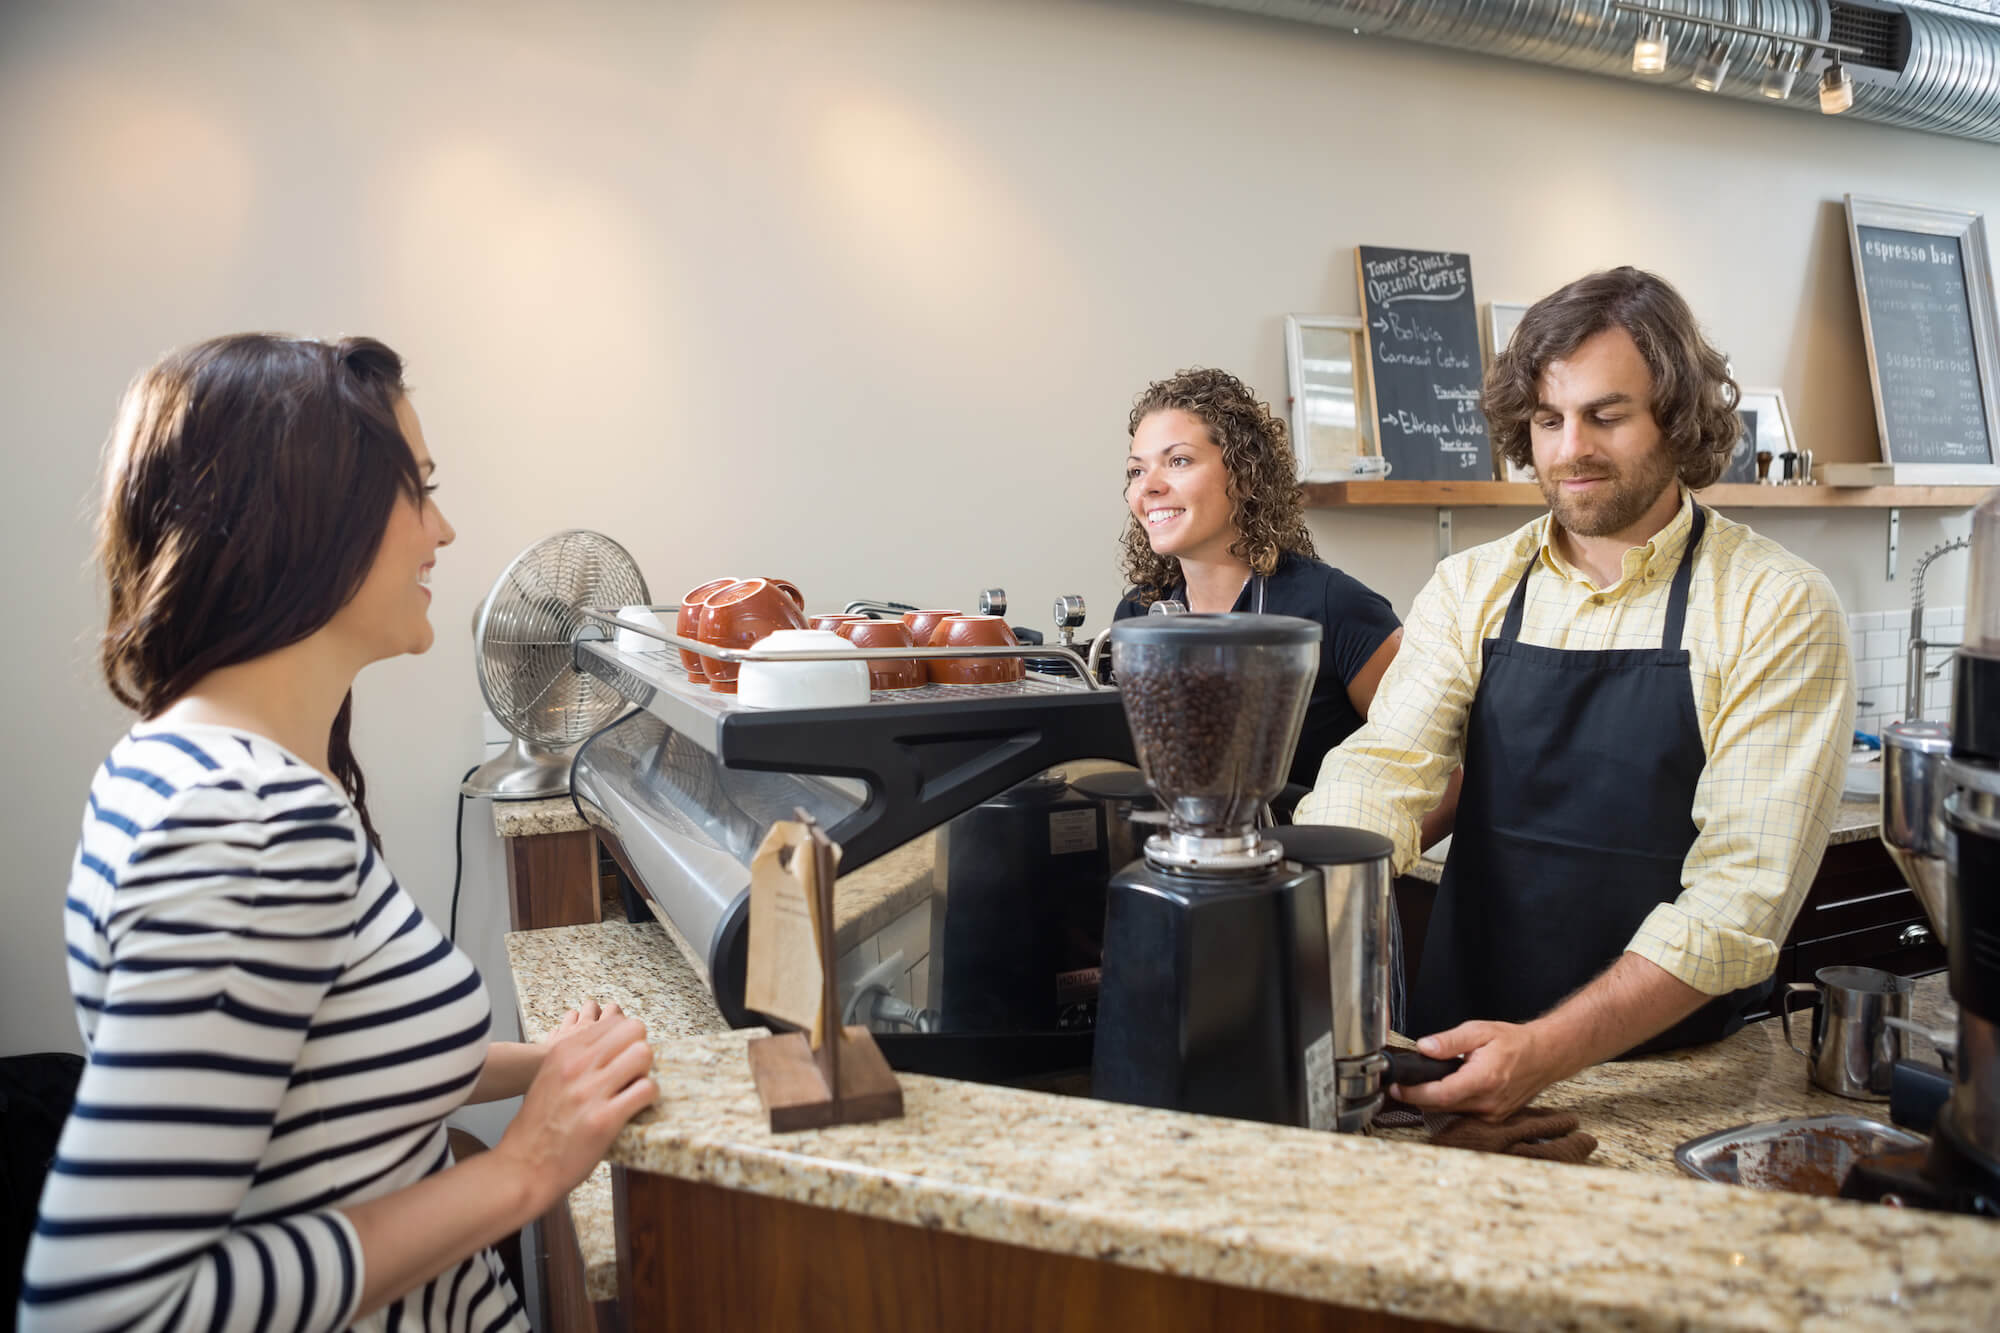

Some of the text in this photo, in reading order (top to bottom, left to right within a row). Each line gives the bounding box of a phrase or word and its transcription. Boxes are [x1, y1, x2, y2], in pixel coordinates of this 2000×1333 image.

[1408, 254, 1454, 276] SINGLE
[1865, 240, 1955, 265] espresso bar
[1368, 267, 1466, 304] ORIGIN COFFEE
[1388, 311, 1442, 341] Bolivia
